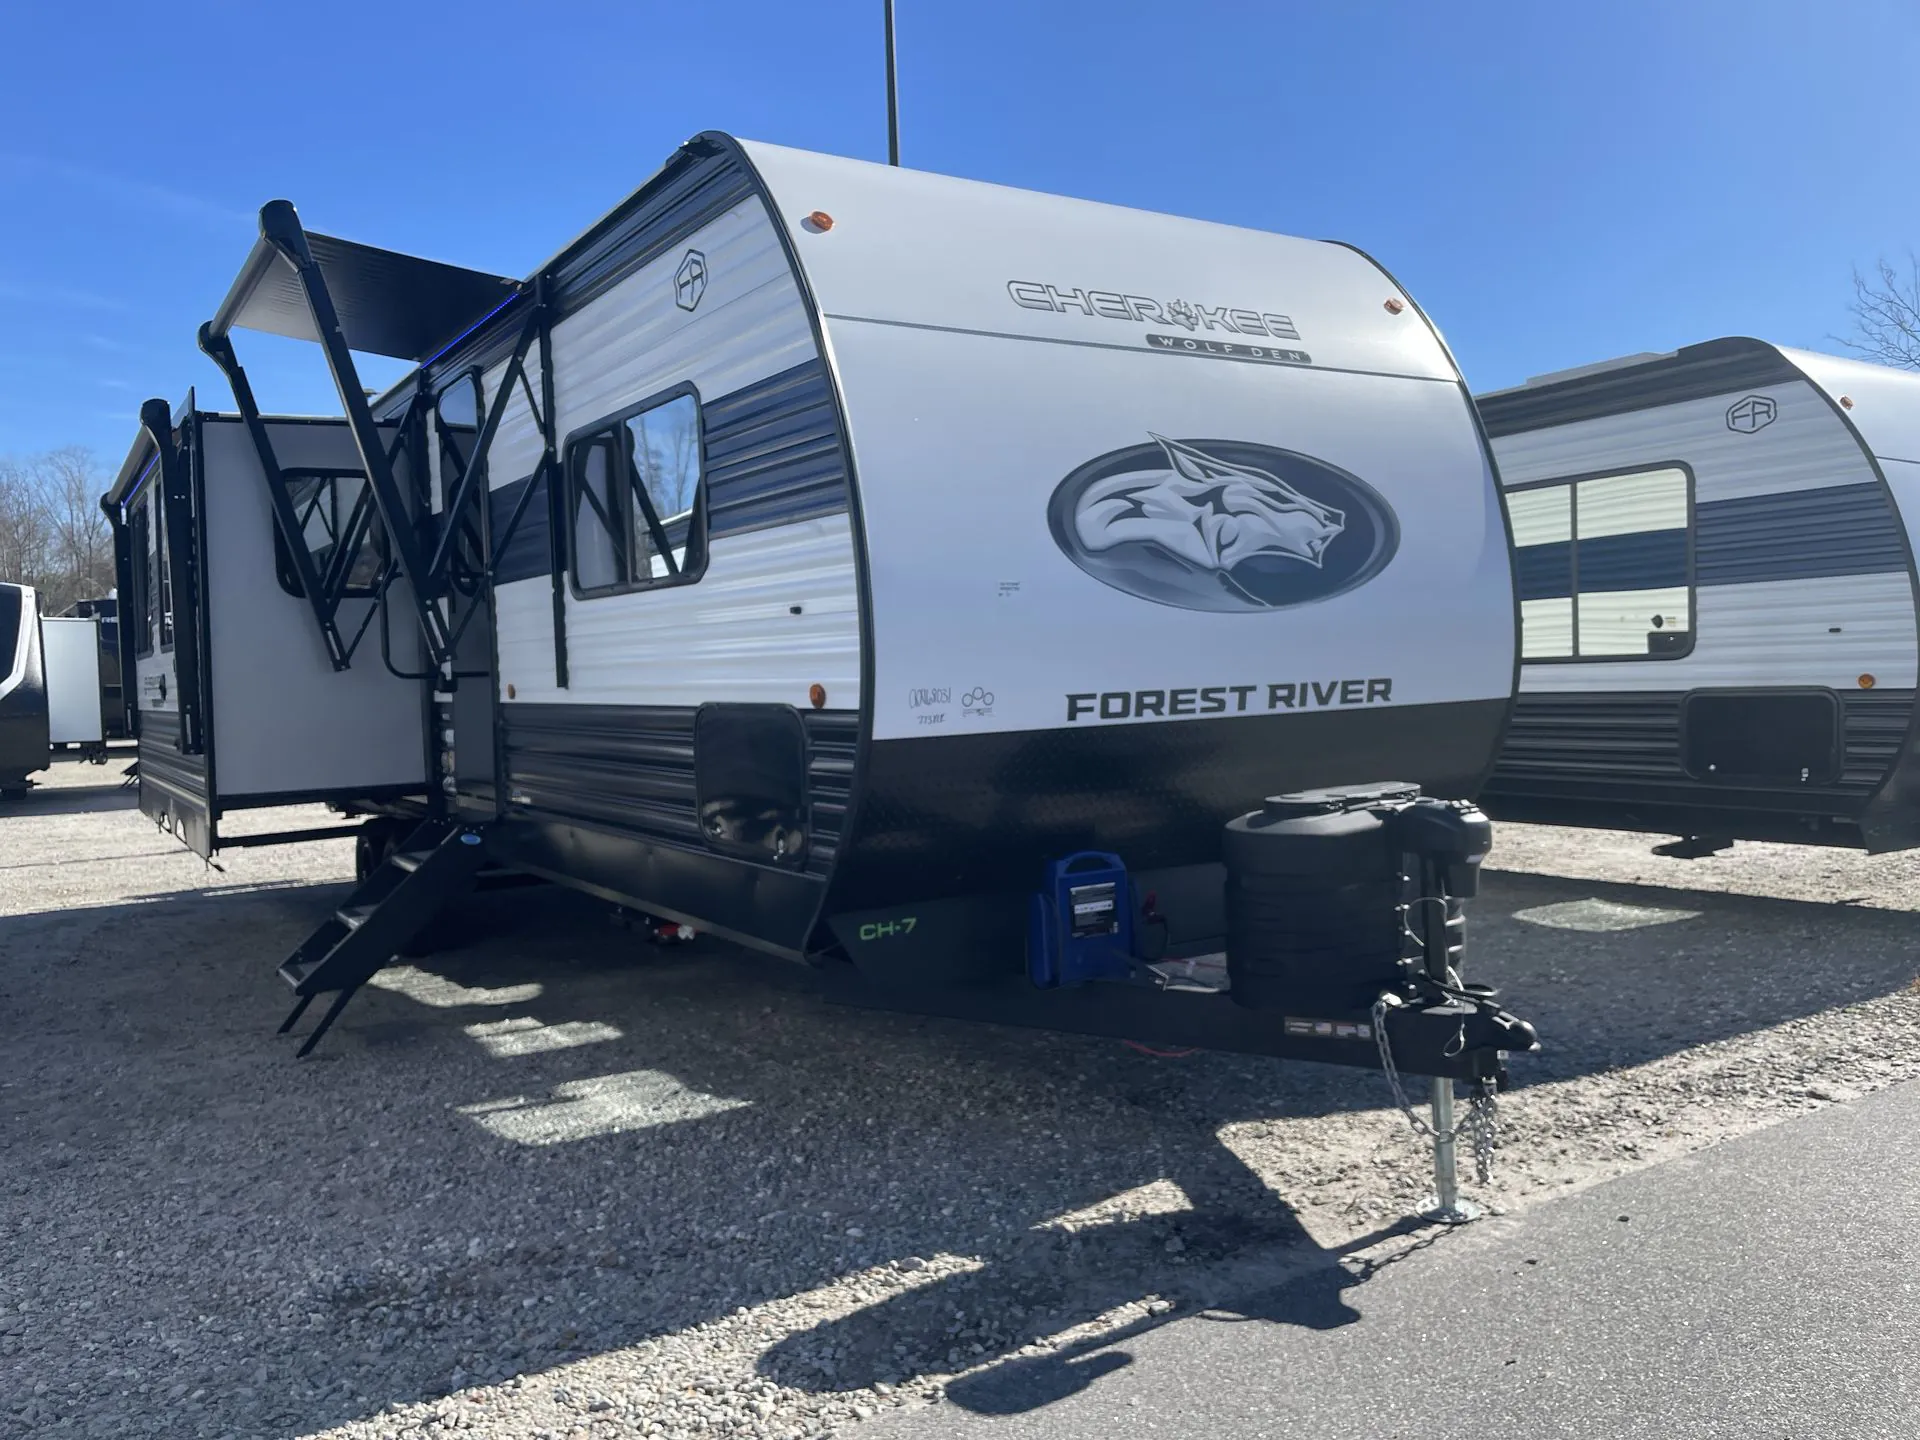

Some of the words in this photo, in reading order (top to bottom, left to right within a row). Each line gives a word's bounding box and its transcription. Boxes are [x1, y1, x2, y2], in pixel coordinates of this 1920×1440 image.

[1158, 335, 1233, 355] WOLF
[1250, 347, 1302, 362] DEN
[1065, 685, 1257, 722] FOREST
[1267, 678, 1394, 710] RIVER
[859, 917, 917, 941] CH-7
